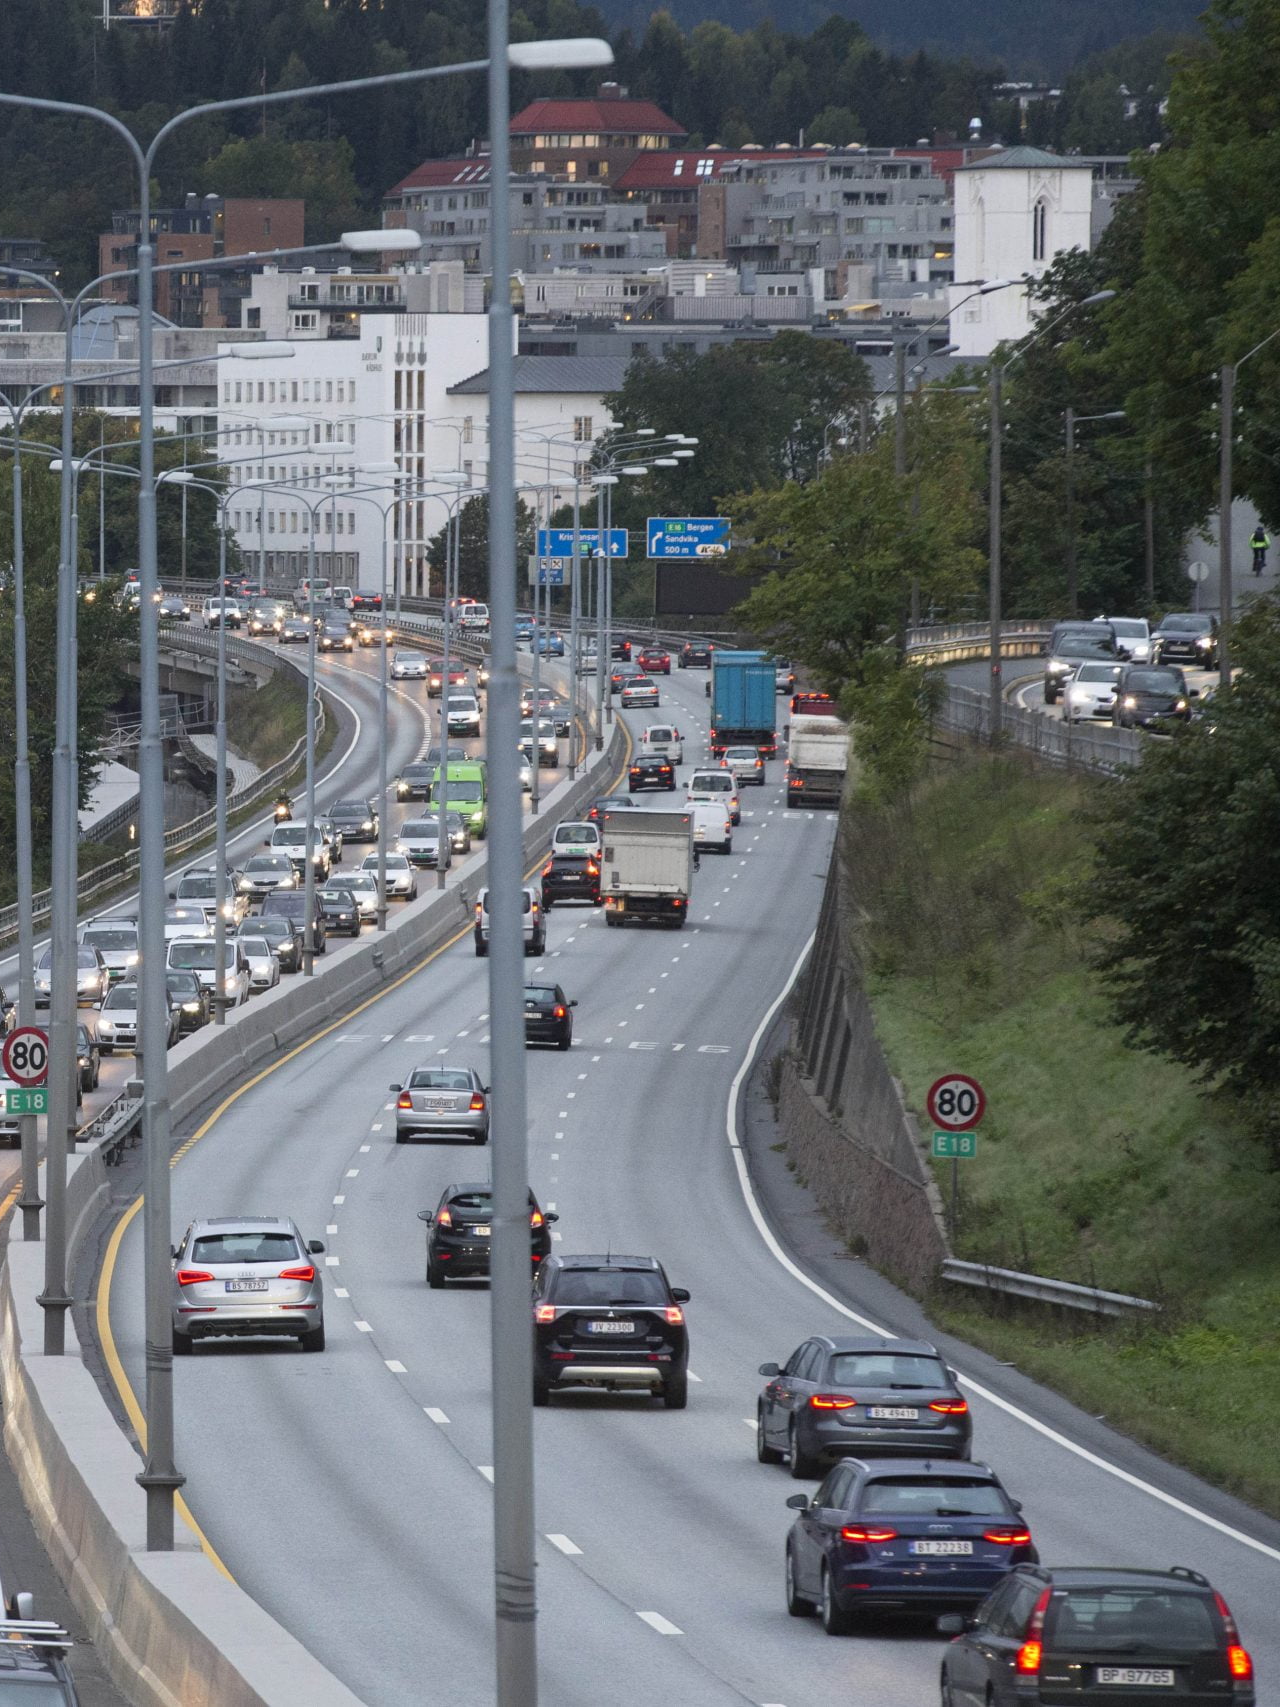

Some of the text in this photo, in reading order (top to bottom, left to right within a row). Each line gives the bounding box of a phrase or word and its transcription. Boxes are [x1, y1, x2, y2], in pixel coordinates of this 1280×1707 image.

[687, 523, 714, 533] Bergen
[558, 533, 602, 541] Krisansan
[665, 535, 699, 543] Sandvika
[664, 546, 680, 554] 500
[12, 1041, 46, 1070] 80
[11, 1093, 44, 1109] E 18
[938, 1088, 976, 1116] 80
[937, 1136, 971, 1152] E 18
[874, 1408, 916, 1417] BS 49419
[917, 1542, 970, 1553] BT 22238
[1102, 1669, 1170, 1683] BP 97765
